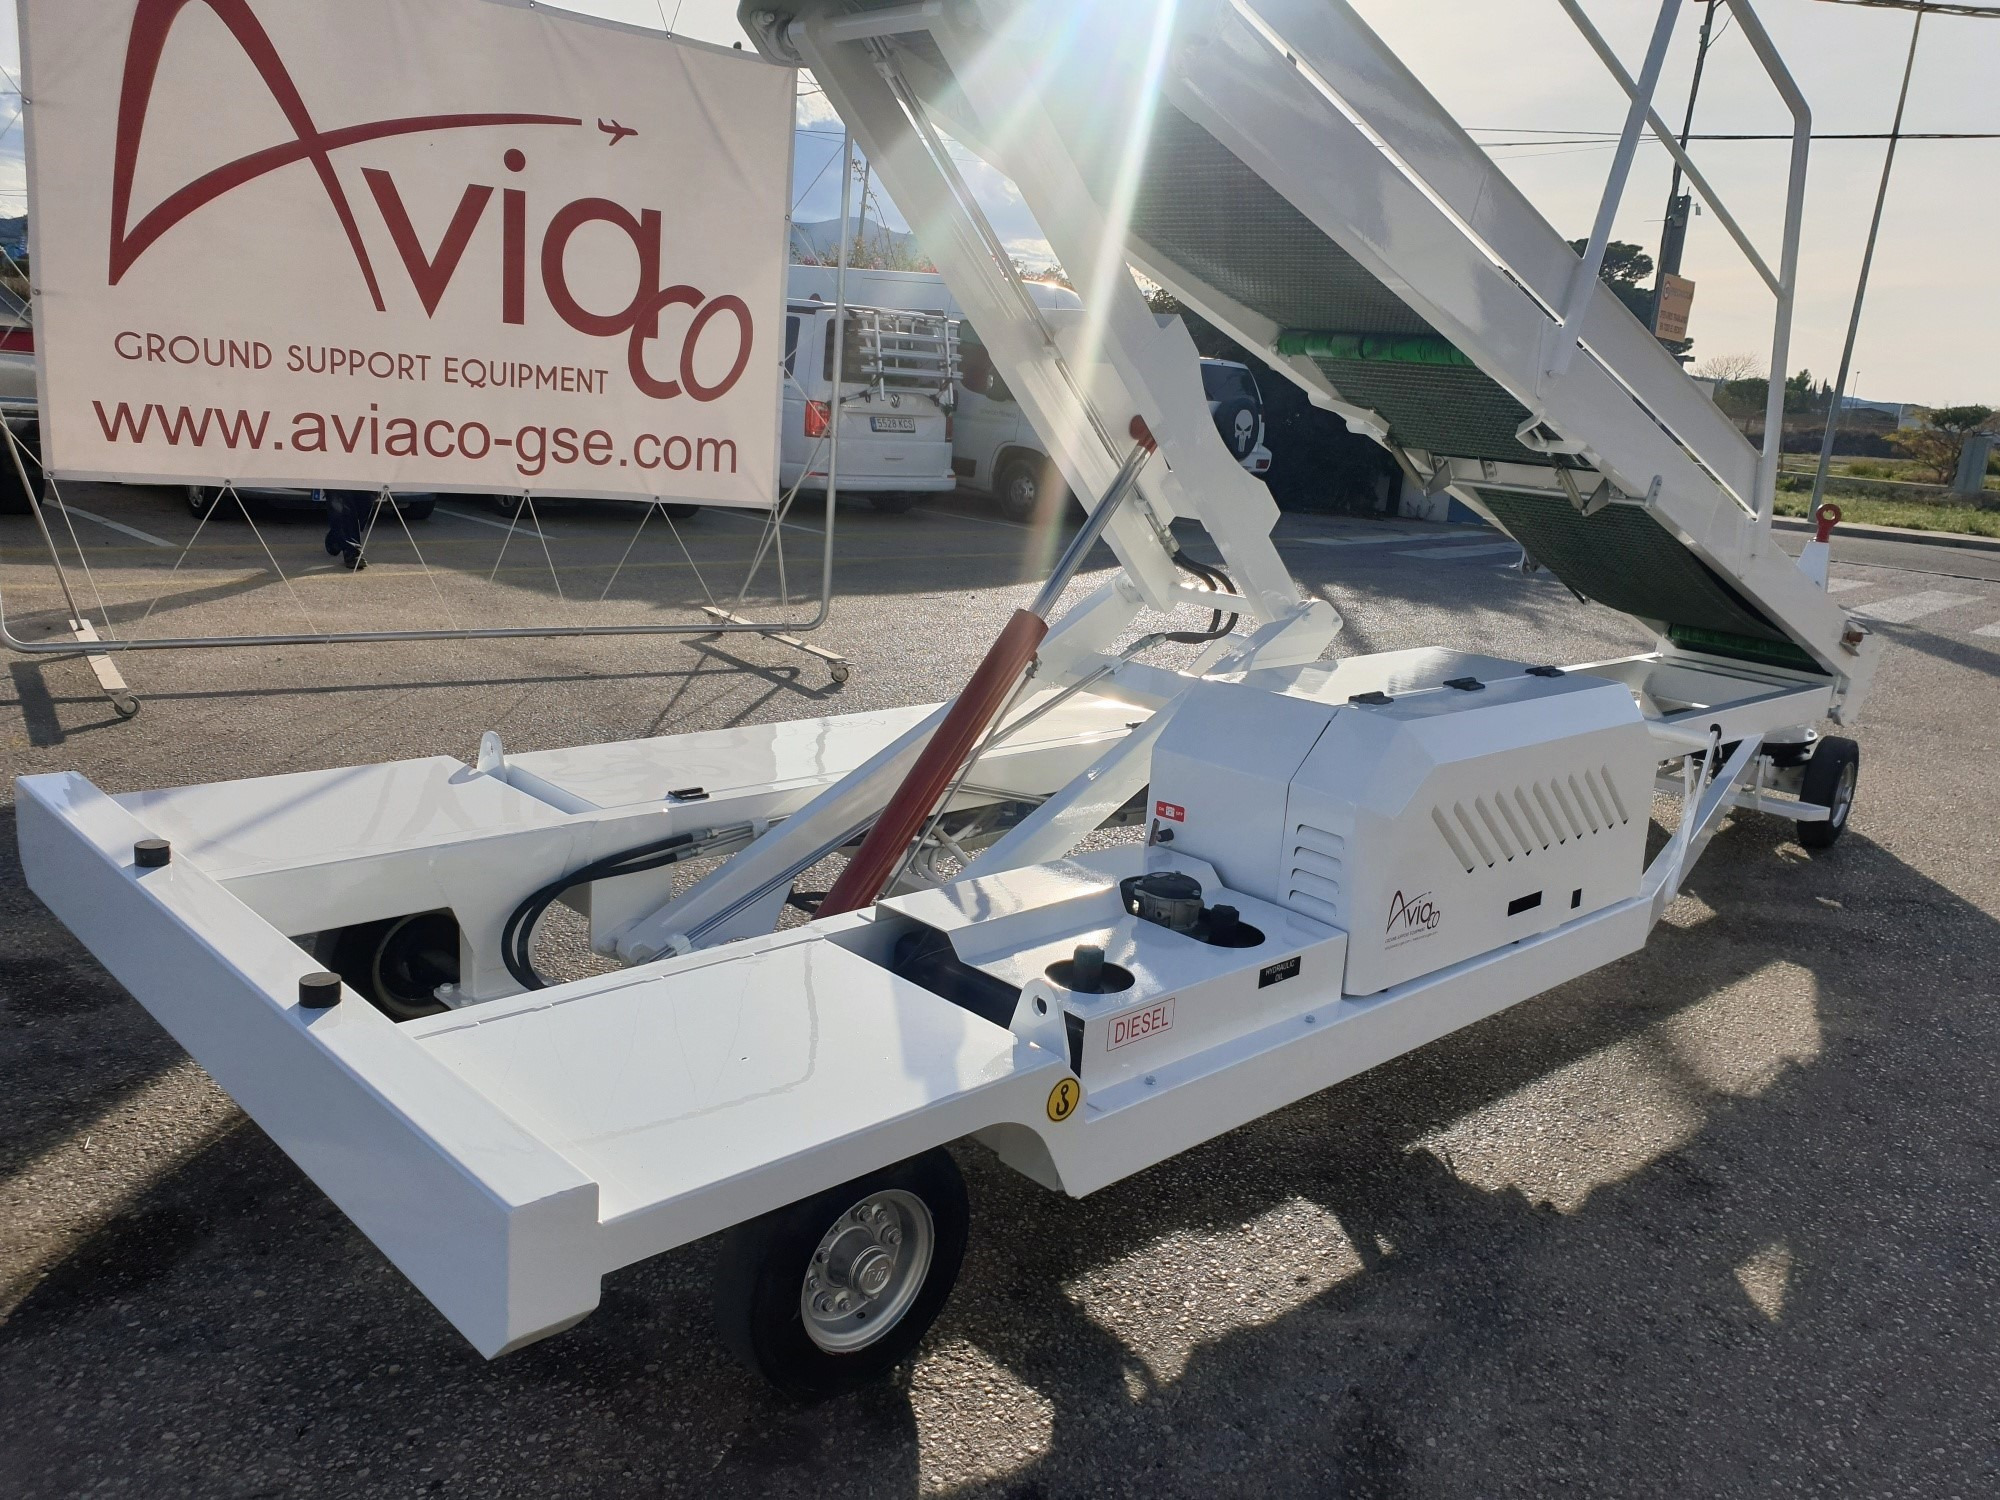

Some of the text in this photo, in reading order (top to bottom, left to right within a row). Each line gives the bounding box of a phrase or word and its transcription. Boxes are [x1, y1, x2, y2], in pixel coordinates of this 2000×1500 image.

[114, 331, 609, 395] GROUND SUPPORT EQUIPMENT
[92, 399, 738, 477] www.aviaco-gse.com
[1265, 960, 1295, 976] HYDRAULIC
[1274, 972, 1283, 981] OIL
[1114, 1006, 1169, 1044] DIESEL
